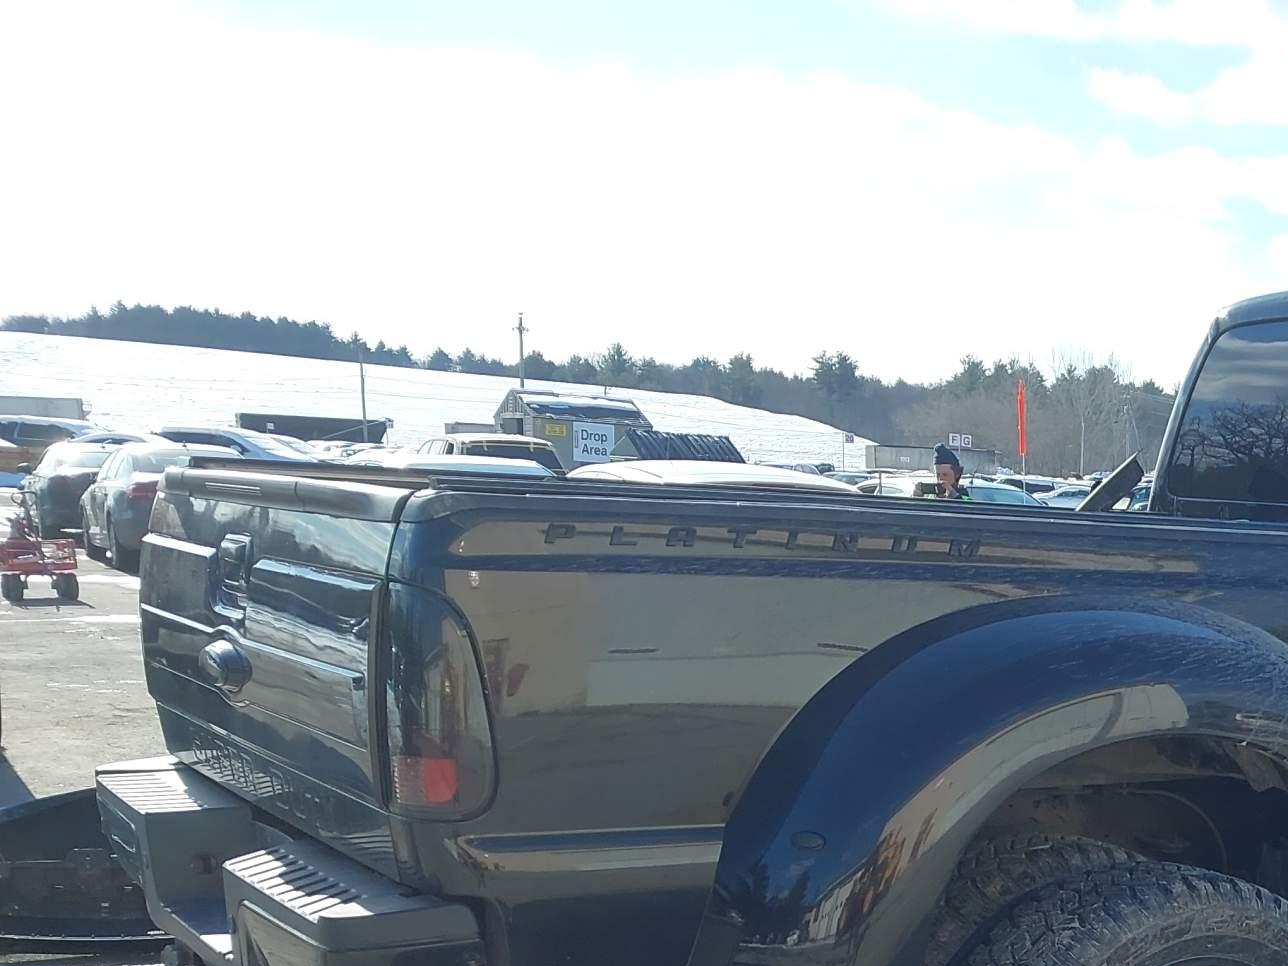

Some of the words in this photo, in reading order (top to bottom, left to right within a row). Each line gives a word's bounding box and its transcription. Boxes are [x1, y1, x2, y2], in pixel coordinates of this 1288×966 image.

[580, 429, 608, 445] Drop
[951, 435, 958, 444] F
[963, 436, 970, 446] G
[581, 444, 608, 457] Area
[543, 522, 981, 560] PLATINUM
